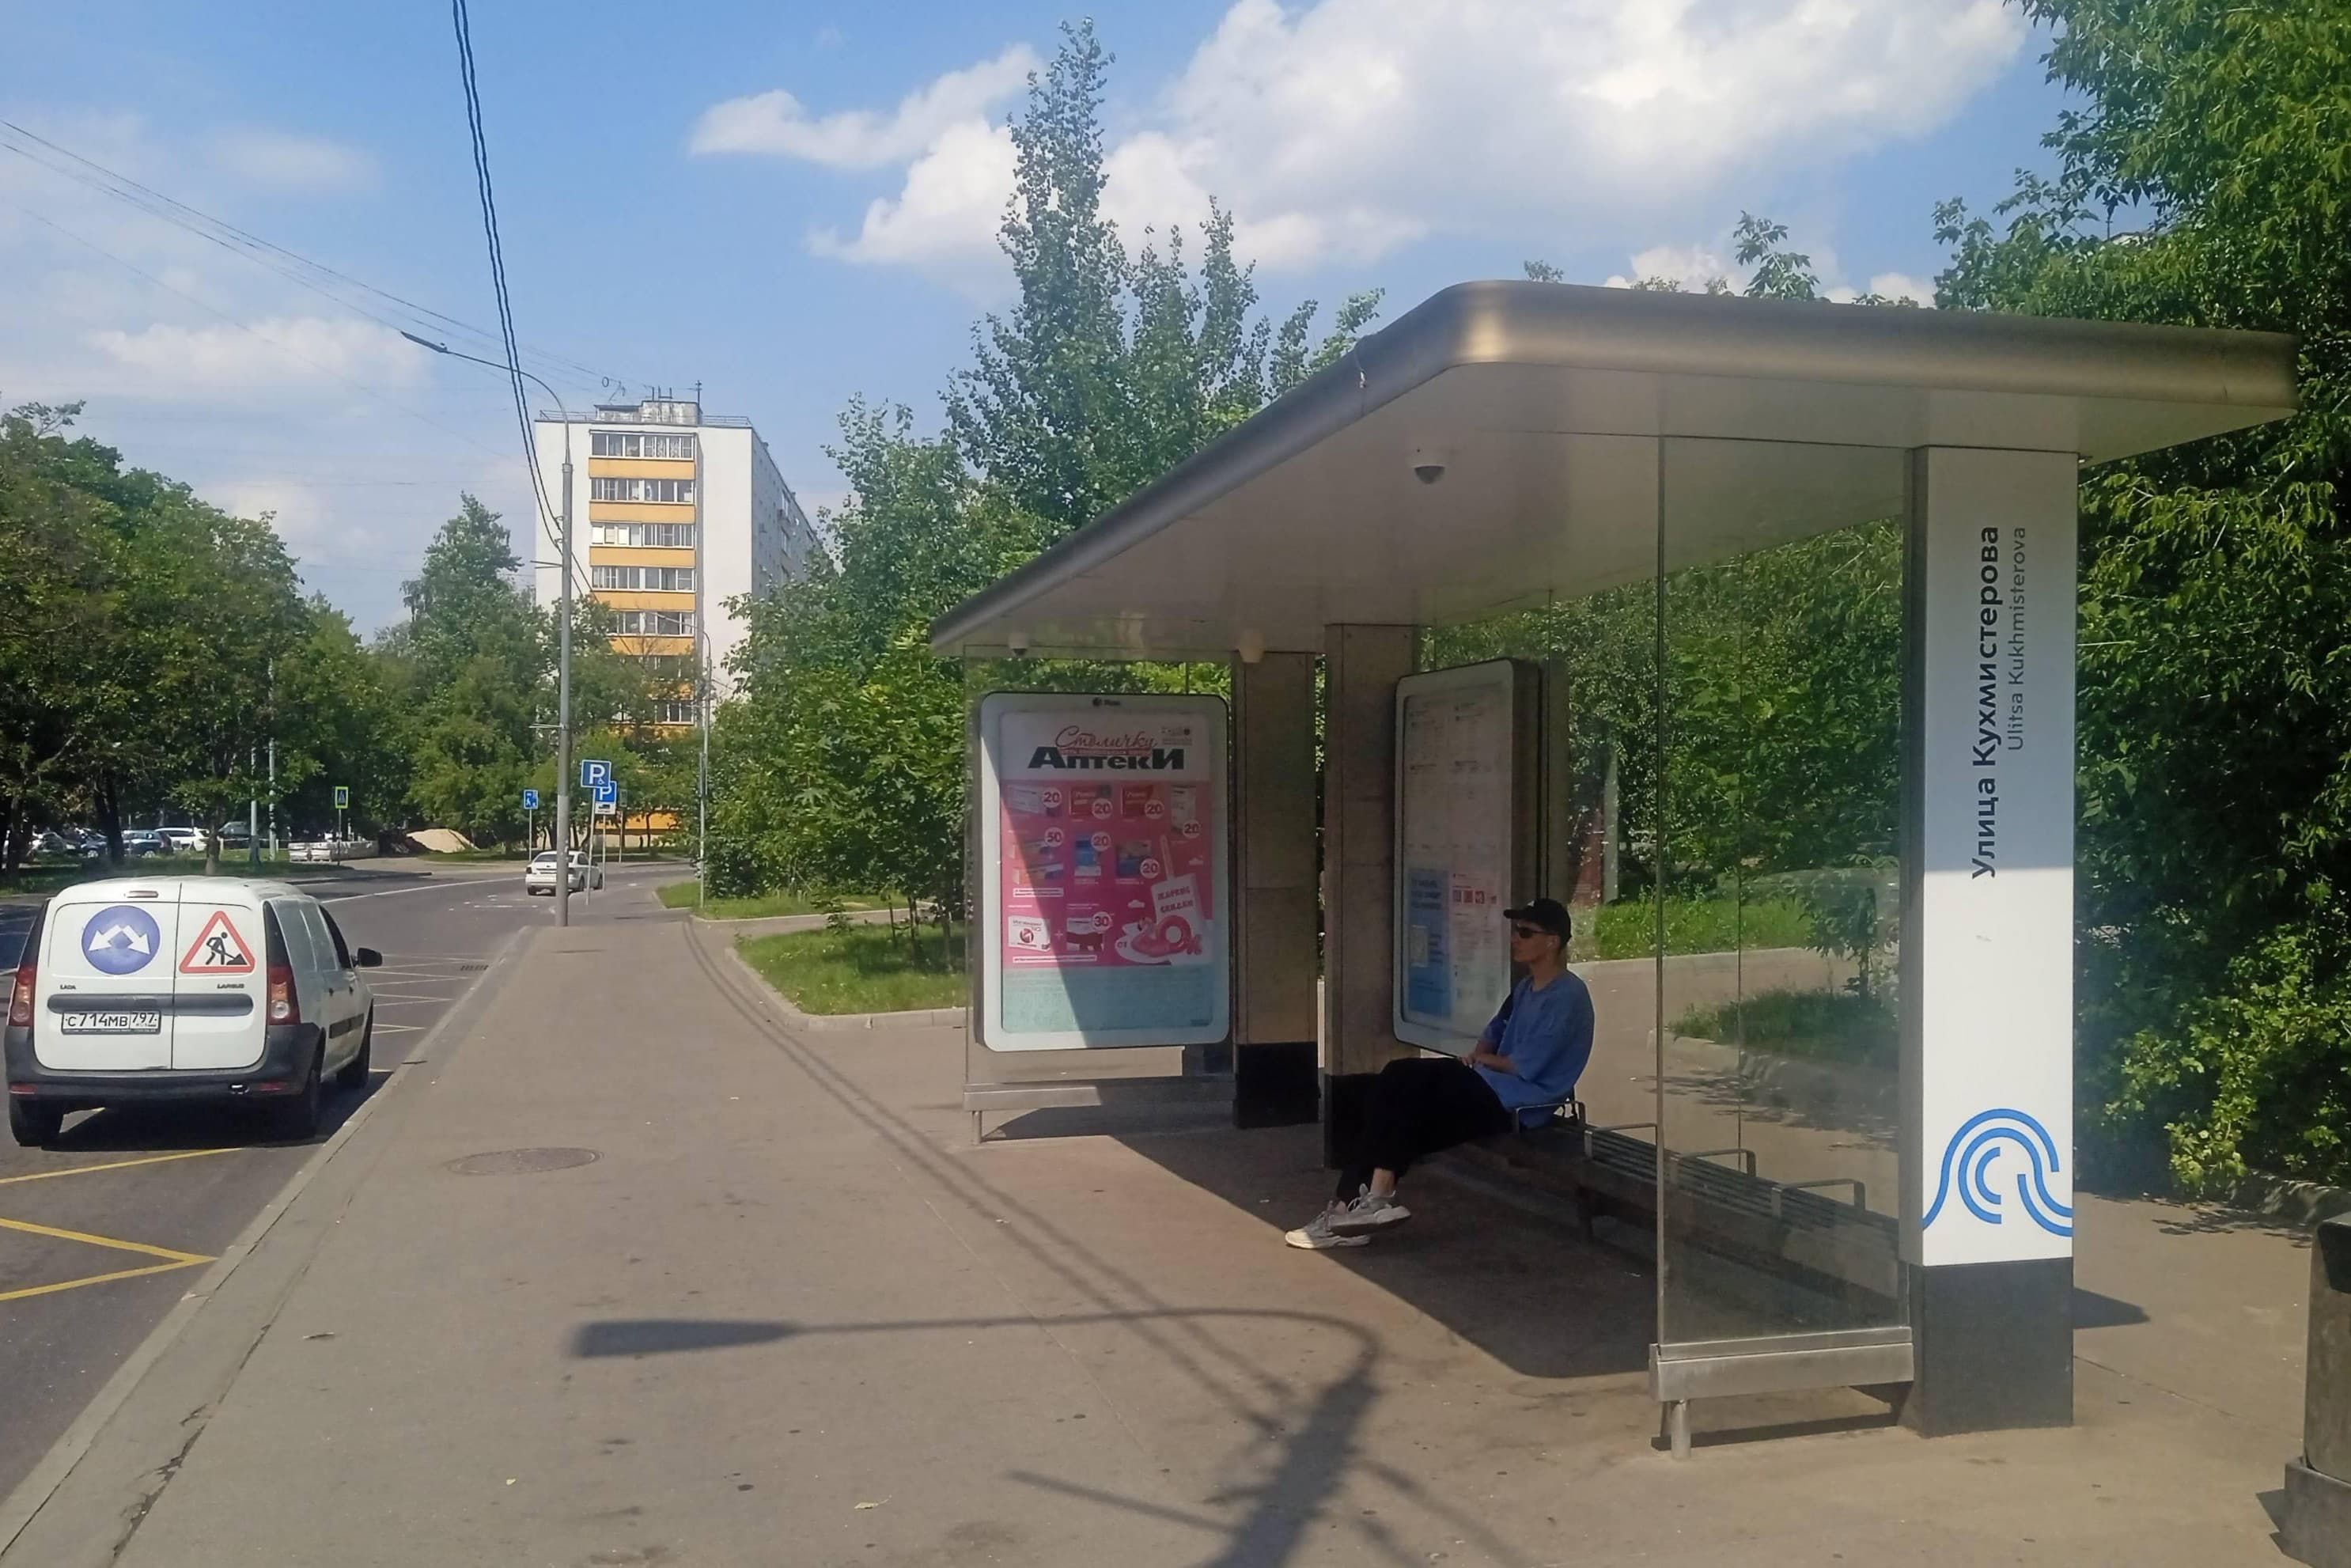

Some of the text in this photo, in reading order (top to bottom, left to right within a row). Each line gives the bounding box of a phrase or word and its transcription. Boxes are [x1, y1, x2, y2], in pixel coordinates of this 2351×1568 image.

[2007, 528, 2026, 750] Ulitsa Kukhmisterova
[1971, 527, 2003, 880] Улица Кухмистерова
[589, 763, 605, 785] P
[1043, 790, 1060, 803] 20
[1094, 803, 1111, 814] 20
[1147, 804, 1163, 815] 20
[1047, 831, 1062, 843] 50
[1093, 835, 1108, 846] 20
[1142, 862, 1158, 873] 20
[1094, 915, 1109, 927] 30
[131, 1012, 154, 1024] 797
